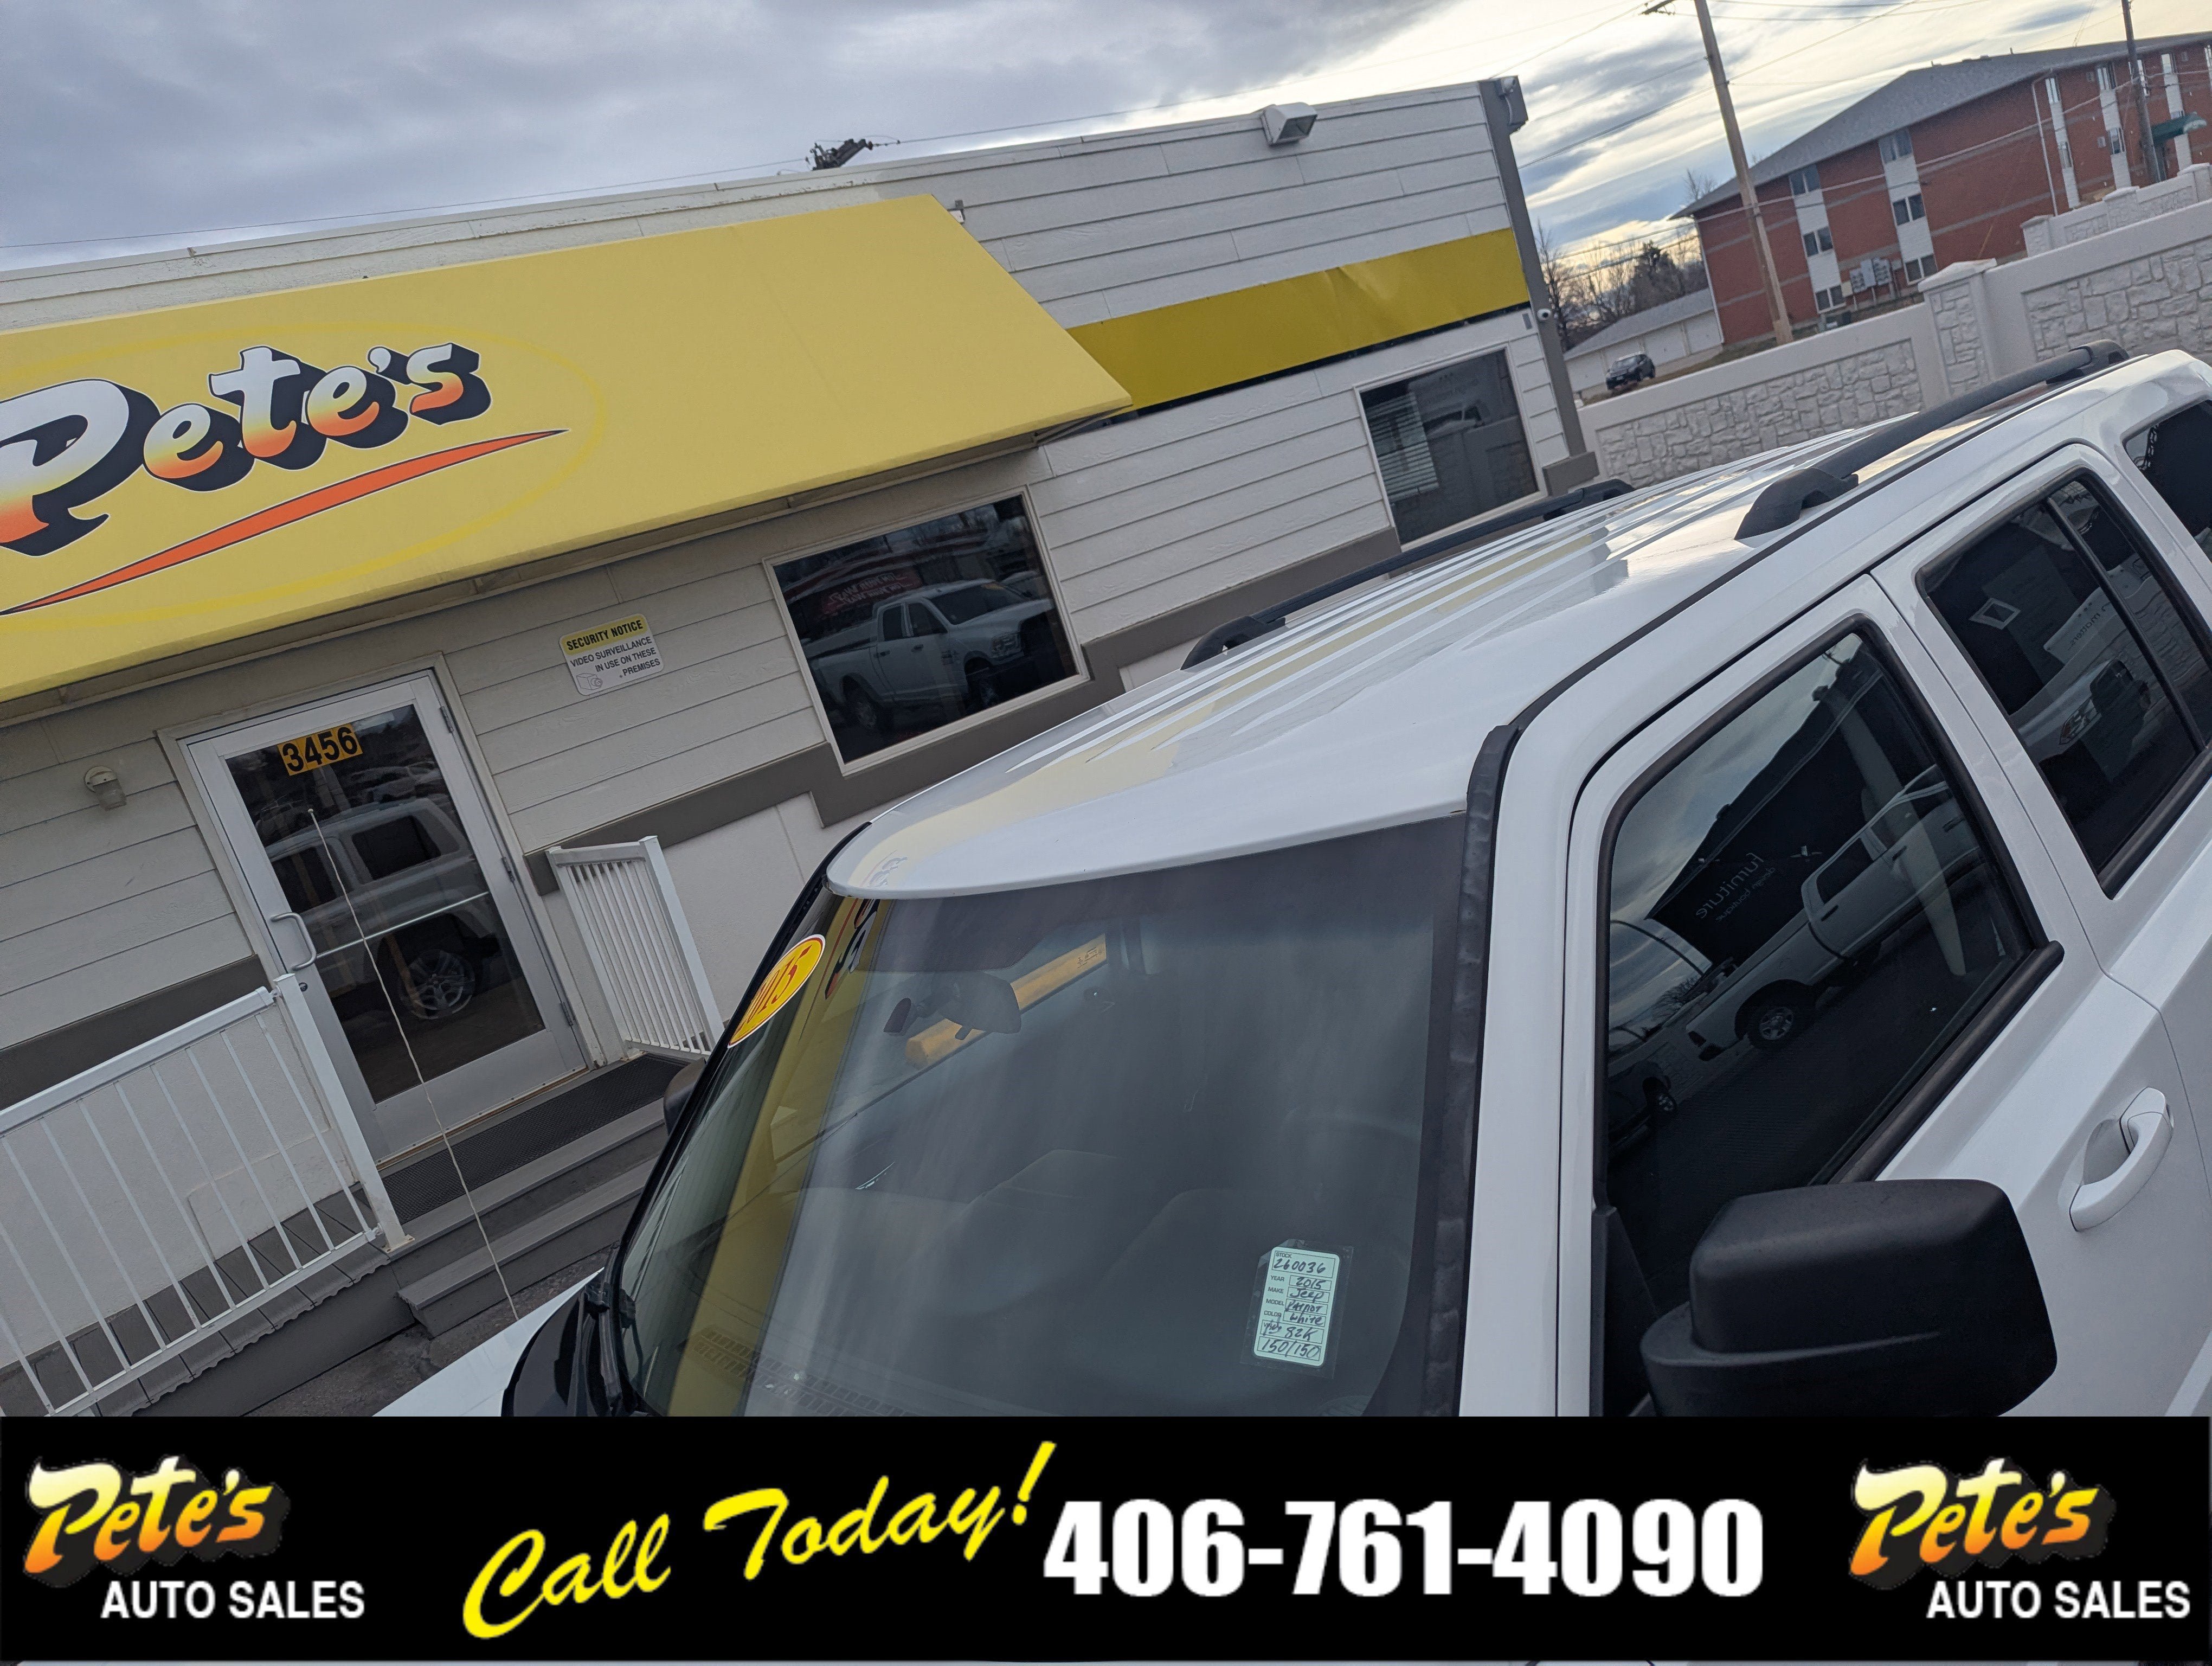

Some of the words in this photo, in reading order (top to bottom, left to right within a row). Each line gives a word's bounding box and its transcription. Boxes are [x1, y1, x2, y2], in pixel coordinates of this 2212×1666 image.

[0, 343, 488, 554] Pete's
[567, 630, 609, 650] SECURITY
[610, 620, 643, 637] NOTICE
[570, 654, 594, 667] VIDEO
[595, 636, 652, 660] SURVEILLANCE
[595, 664, 603, 672] IN
[605, 659, 620, 669] USE
[621, 655, 632, 664] ON
[632, 647, 657, 661] THESE
[622, 658, 660, 676] PREMISES
[282, 727, 357, 772] 3456
[1274, 1258, 1326, 1273] 260036
[1290, 1288, 1324, 1303] Jeep
[1296, 1277, 1326, 1290] 2015
